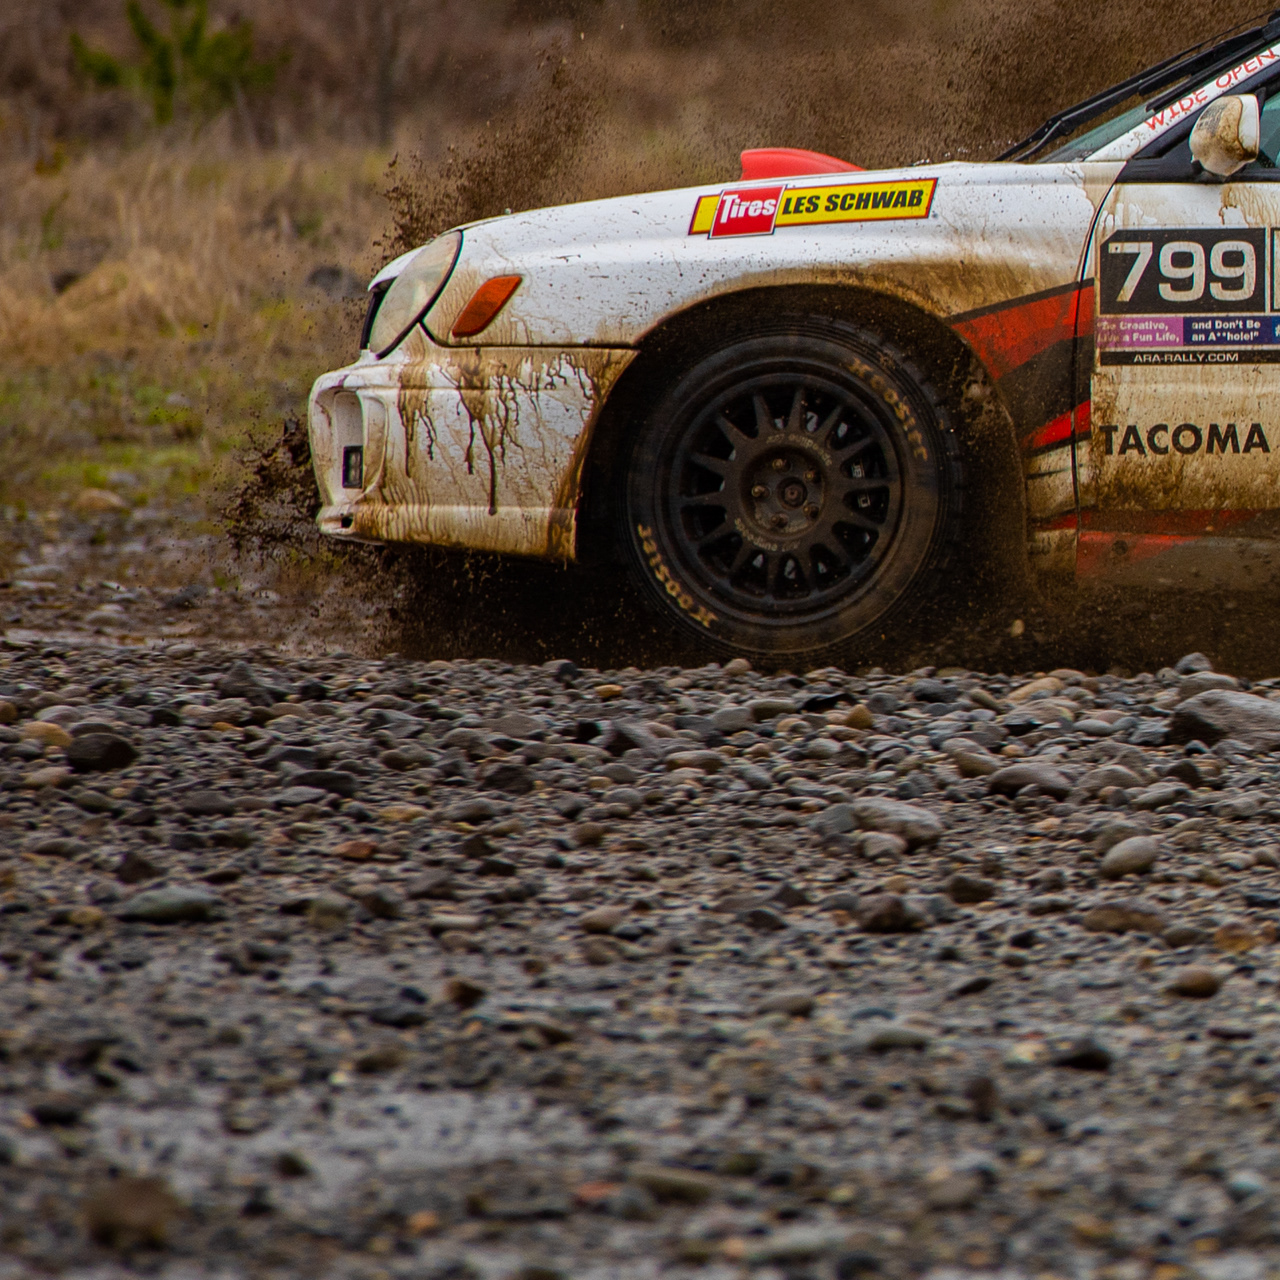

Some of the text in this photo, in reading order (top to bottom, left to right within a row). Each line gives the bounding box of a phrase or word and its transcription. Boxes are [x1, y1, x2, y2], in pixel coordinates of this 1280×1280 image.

[1143, 87, 1209, 132] WIDE
[1215, 47, 1280, 90] OPEN
[720, 194, 776, 223] Tires
[782, 189, 924, 215] LES SCHWAB
[1108, 240, 1257, 303] 799
[1119, 320, 1168, 331] Creative,
[1192, 319, 1261, 330] and Don't Be
[1132, 332, 1153, 342] Fun
[1155, 331, 1180, 343] Life,
[1192, 333, 1206, 342] an
[1133, 352, 1239, 363] ARA-RALLY.COM
[1100, 422, 1271, 456] TACOMA
